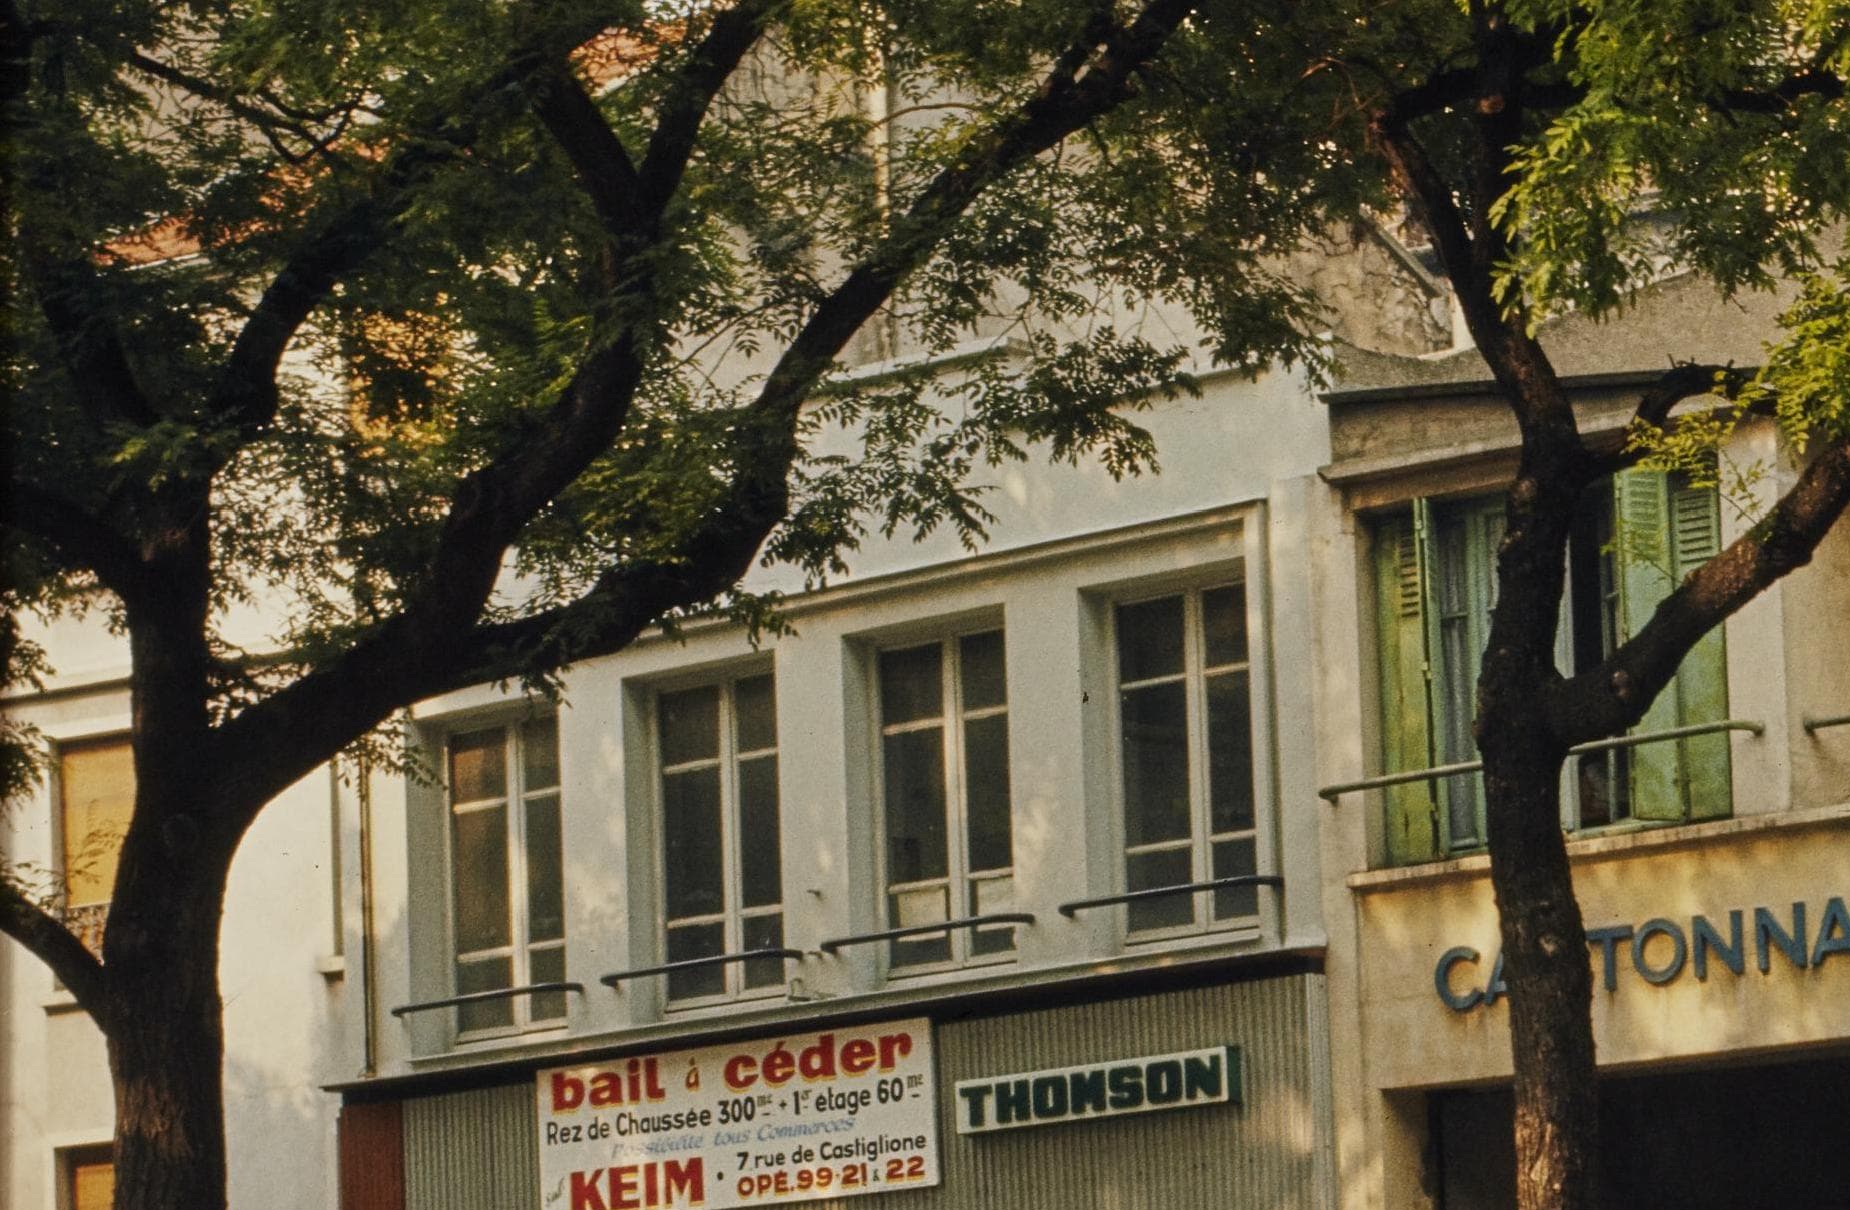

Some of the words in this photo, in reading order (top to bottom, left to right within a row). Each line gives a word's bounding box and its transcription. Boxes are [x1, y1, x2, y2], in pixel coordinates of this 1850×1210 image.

[552, 1057, 666, 1115] bail
[723, 1032, 912, 1093] céder
[959, 1054, 1221, 1128] THOMSON
[547, 1121, 582, 1146] Rez
[587, 1116, 611, 1140] de
[616, 1107, 712, 1137] Chaussée
[737, 1151, 749, 1171] 7
[755, 1152, 786, 1168] rue
[791, 1145, 815, 1165] de
[819, 1134, 927, 1162] Castiglione
[886, 1155, 926, 1183] 22
